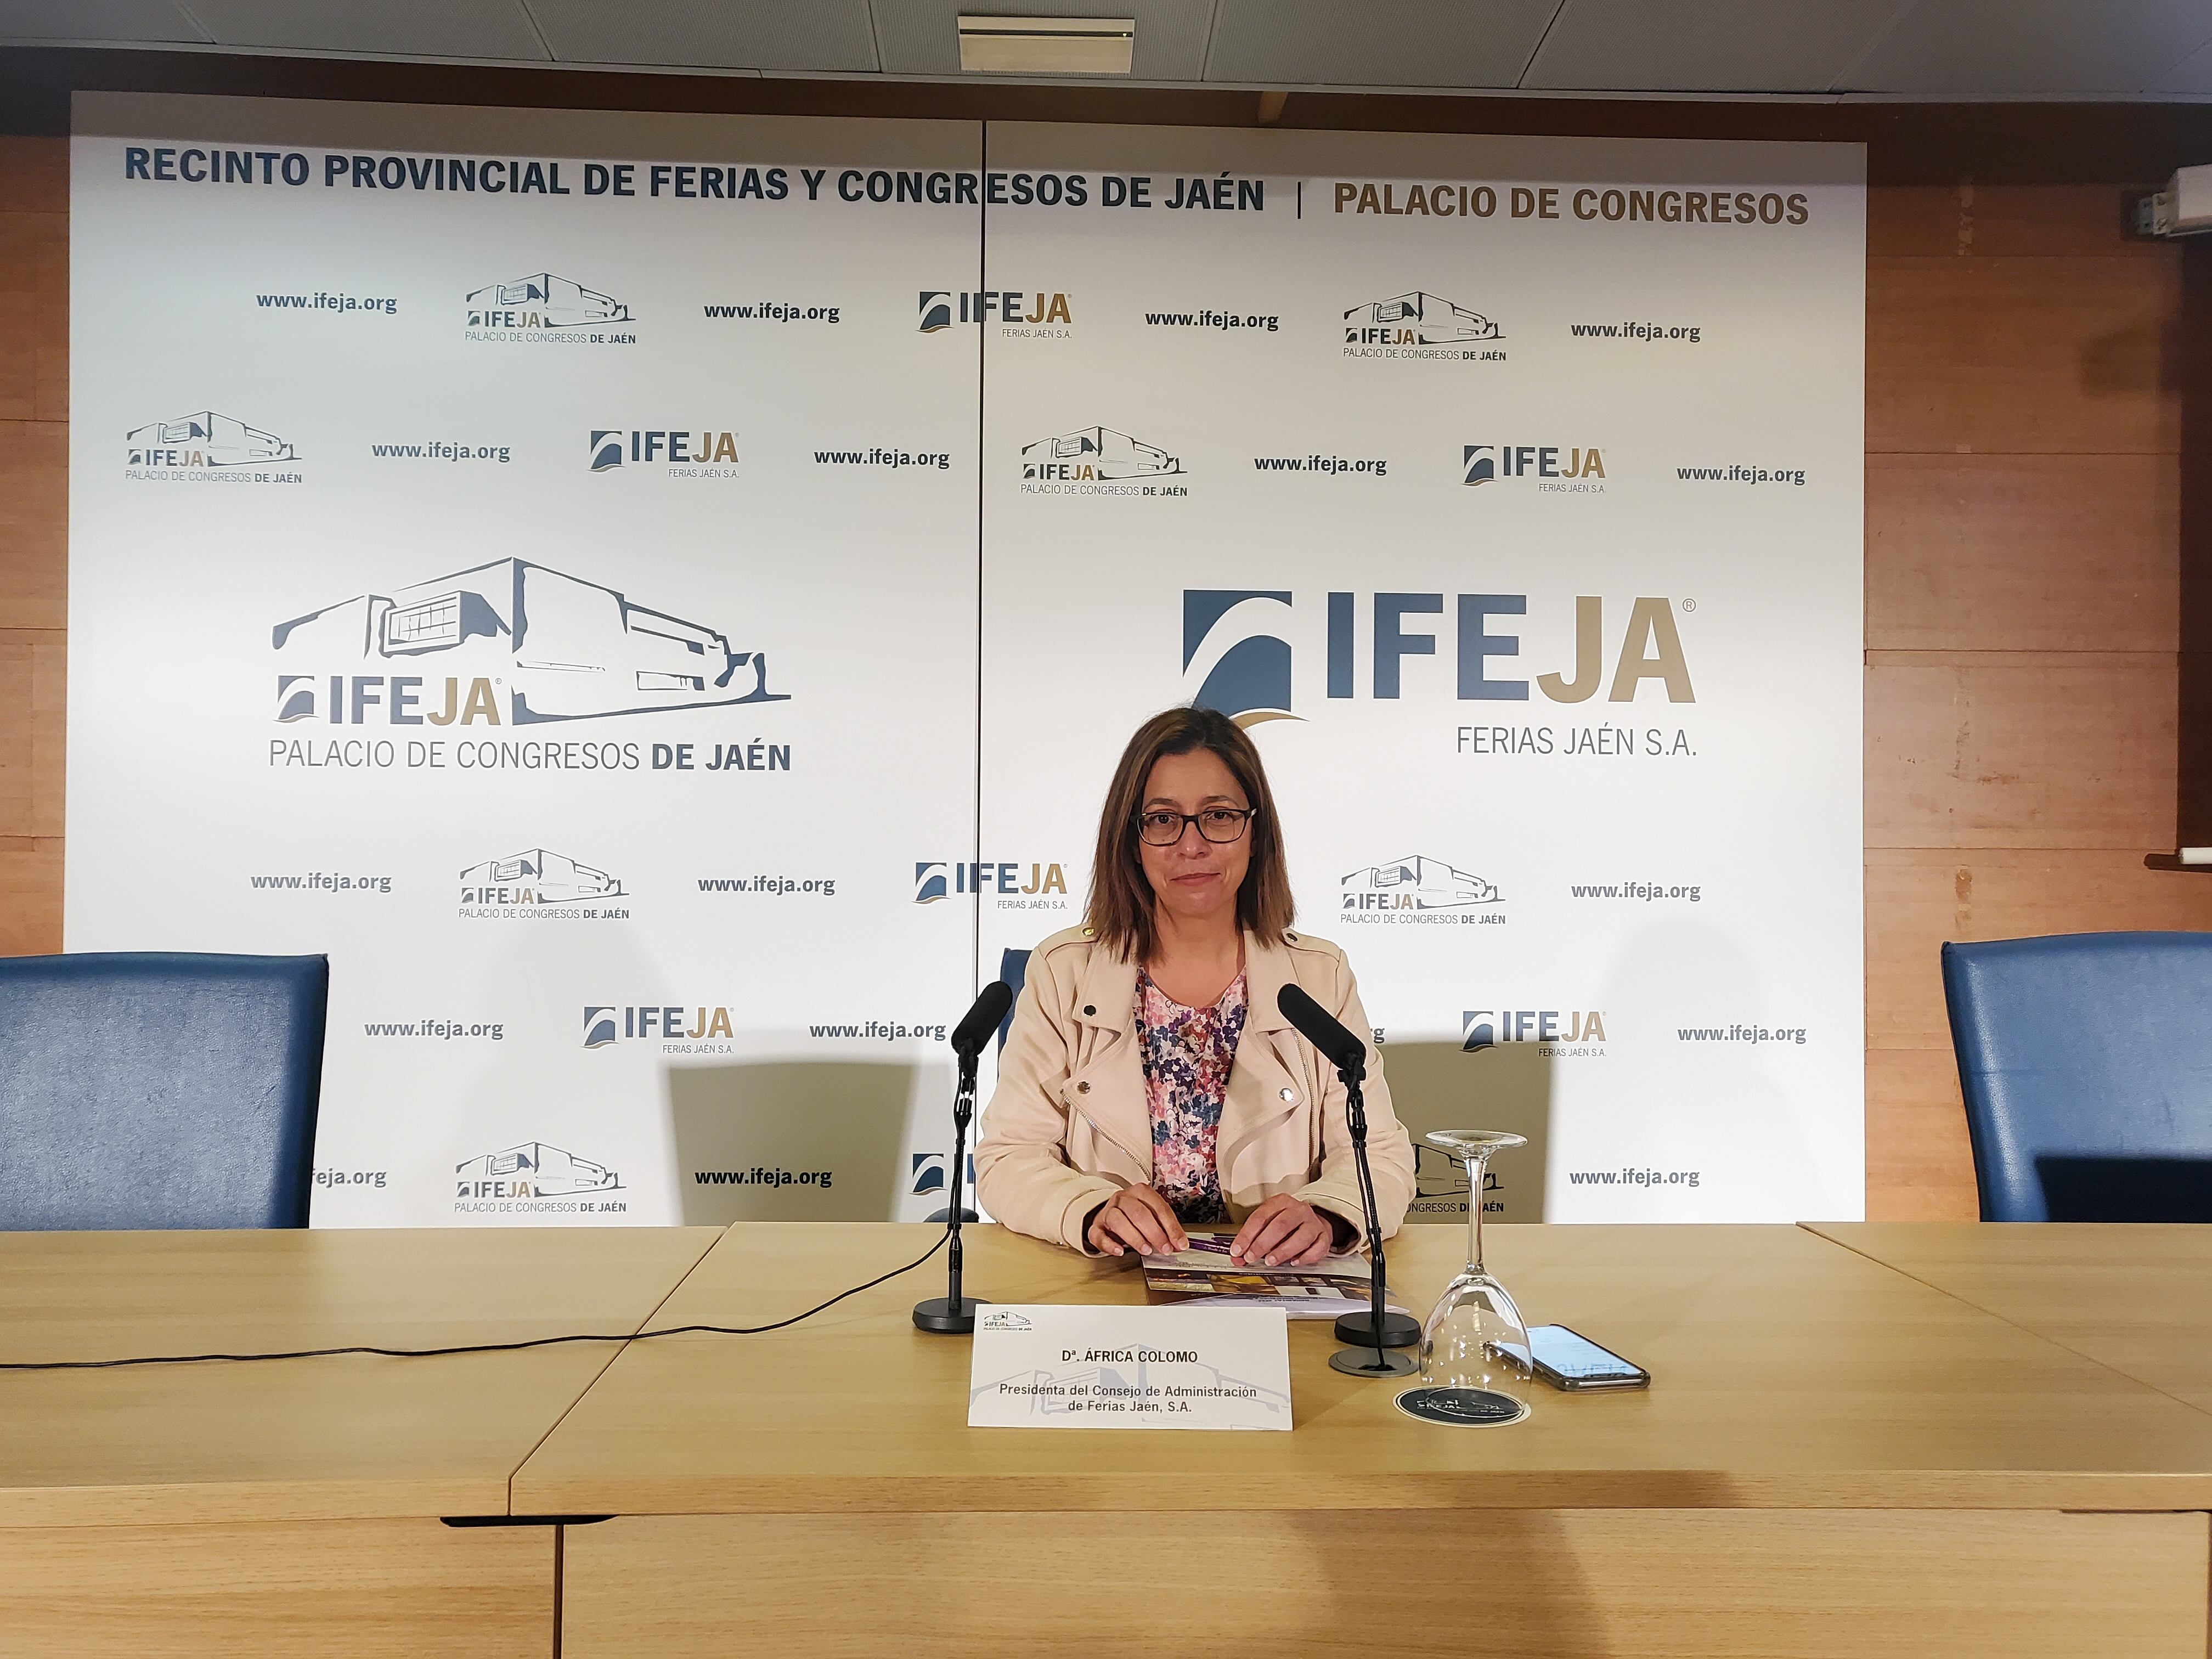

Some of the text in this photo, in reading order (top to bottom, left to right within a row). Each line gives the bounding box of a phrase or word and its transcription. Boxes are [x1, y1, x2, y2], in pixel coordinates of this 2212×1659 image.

[125, 147, 1264, 211] RECINTO PROVINCIAL DE FERIAS Y CONGRESOS DE JAÉN
[1334, 183, 1809, 224] PALACIO DE CONGRESOS
[257, 292, 397, 314] www.ifeja.org
[960, 292, 1071, 323] IFEJA
[485, 311, 540, 328] IFEJA
[704, 303, 839, 323] www.ifeja.org
[1146, 311, 1278, 331] www.ifeja.org
[466, 332, 635, 343] PALACIO DE CONGRESOS DE JAÉN
[1003, 329, 1030, 337] FERIAS
[1033, 330, 1053, 338] JAÉN
[1362, 328, 1415, 345] IFEJA
[1571, 322, 1700, 342] www.ifeja.org
[1344, 348, 1506, 360] PALACIO DE CONGRESOS DE JAÉN
[372, 442, 510, 462] www.ifeja.org
[632, 431, 738, 462] IFEJA
[146, 450, 203, 466] IFEJA
[814, 449, 949, 469] www.ifeja.org
[1255, 455, 1386, 476] www.ifeja.org
[1504, 447, 1605, 478] IFEJA
[126, 470, 301, 483] PALACIO DE CONGRESOS DE JAÉN
[669, 469, 697, 477] FERIAS
[1040, 464, 1094, 480] IFEJA
[1677, 465, 1805, 486] www.ifeja.org
[1022, 484, 1187, 496] PALACIO DE CONGRESOS DE JAÉN
[1539, 484, 1566, 492] FERIAS
[1568, 483, 1588, 493] JAÉN
[1458, 722, 1696, 755] FERIAS JAÉN S.A.
[270, 738, 790, 770] PALACIO DE CONGRESOS DE JAÉN
[251, 872, 391, 893] www.ifeja.org
[698, 876, 835, 895] www.ifeja.org
[956, 862, 1067, 894] IFEJA
[478, 888, 534, 904] IFEJA
[1571, 882, 1700, 901] www.ifeja.org
[1359, 894, 1413, 909] IFEJA
[459, 907, 629, 918] PALACIO DE CONGRESOS DE JAÉN
[1341, 913, 1505, 924] PALACIO DE CONGRESOS DE JAÉN
[365, 1020, 503, 1040] www.ifeja.org
[625, 1007, 733, 1038] IFEJA
[810, 1022, 946, 1041] www.ifeja.org
[1503, 1012, 1606, 1041] IFEJA
[1678, 1025, 1806, 1044] www.ifeja.org
[694, 1043, 715, 1053] JAÉN
[718, 1045, 733, 1053] S.A.
[1539, 1047, 1606, 1057] FERIAS JAÉN S.A.
[695, 1167, 832, 1188] www.ifeja.org
[1570, 1168, 1700, 1187] www.ifeja.org
[474, 1182, 530, 1198] IFEJA
[454, 1200, 626, 1212] PALACIO DE CONGRESOS DE JAÉN
[1482, 1200, 1504, 1212] AÉN
[1085, 1347, 1133, 1362] ÁFRICA
[1138, 1351, 1198, 1363] COLOMO
[1000, 1384, 1257, 1398] Presidenta del Consejo de Administración
[1068, 1400, 1192, 1413] de Ferias Jaén, S.A.
